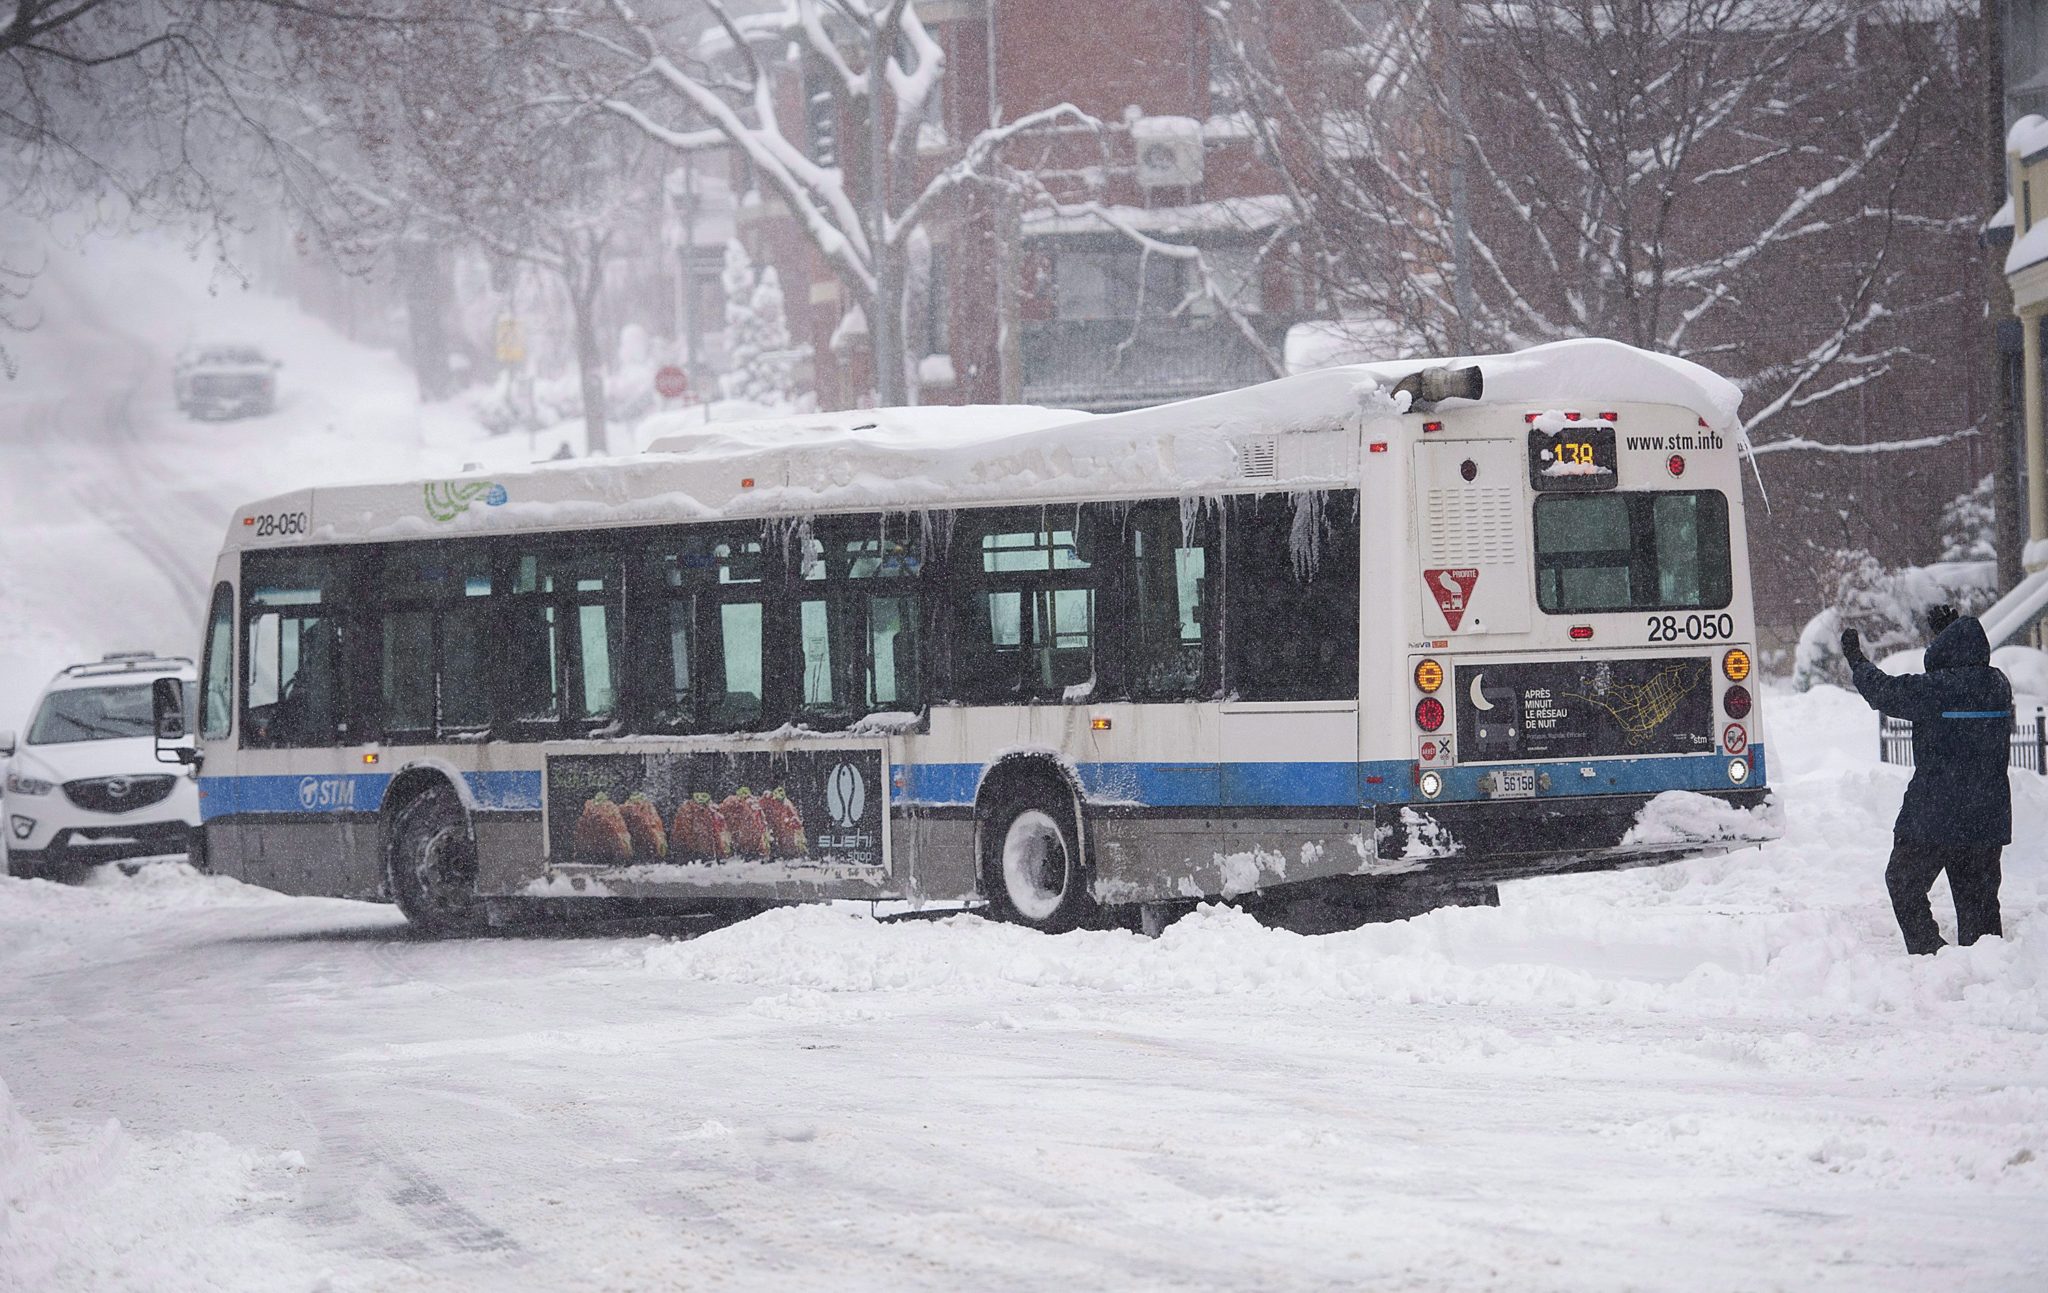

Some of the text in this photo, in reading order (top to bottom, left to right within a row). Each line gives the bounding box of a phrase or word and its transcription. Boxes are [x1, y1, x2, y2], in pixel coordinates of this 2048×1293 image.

[1626, 431, 1723, 450] www.stm.info
[1554, 443, 1593, 465] 138
[256, 512, 306, 536] 28-050
[1647, 613, 1734, 642] 28-050
[1525, 688, 1551, 699] APRÈS
[1525, 700, 1552, 708] MINUIT
[1525, 707, 1568, 719] LE RÉSEAU
[1526, 719, 1556, 729] DE NUIT
[1693, 735, 1708, 744] stm
[1504, 776, 1534, 791] 56158
[320, 780, 355, 805] STM
[818, 827, 873, 847] sushi
[847, 849, 872, 864] shop
